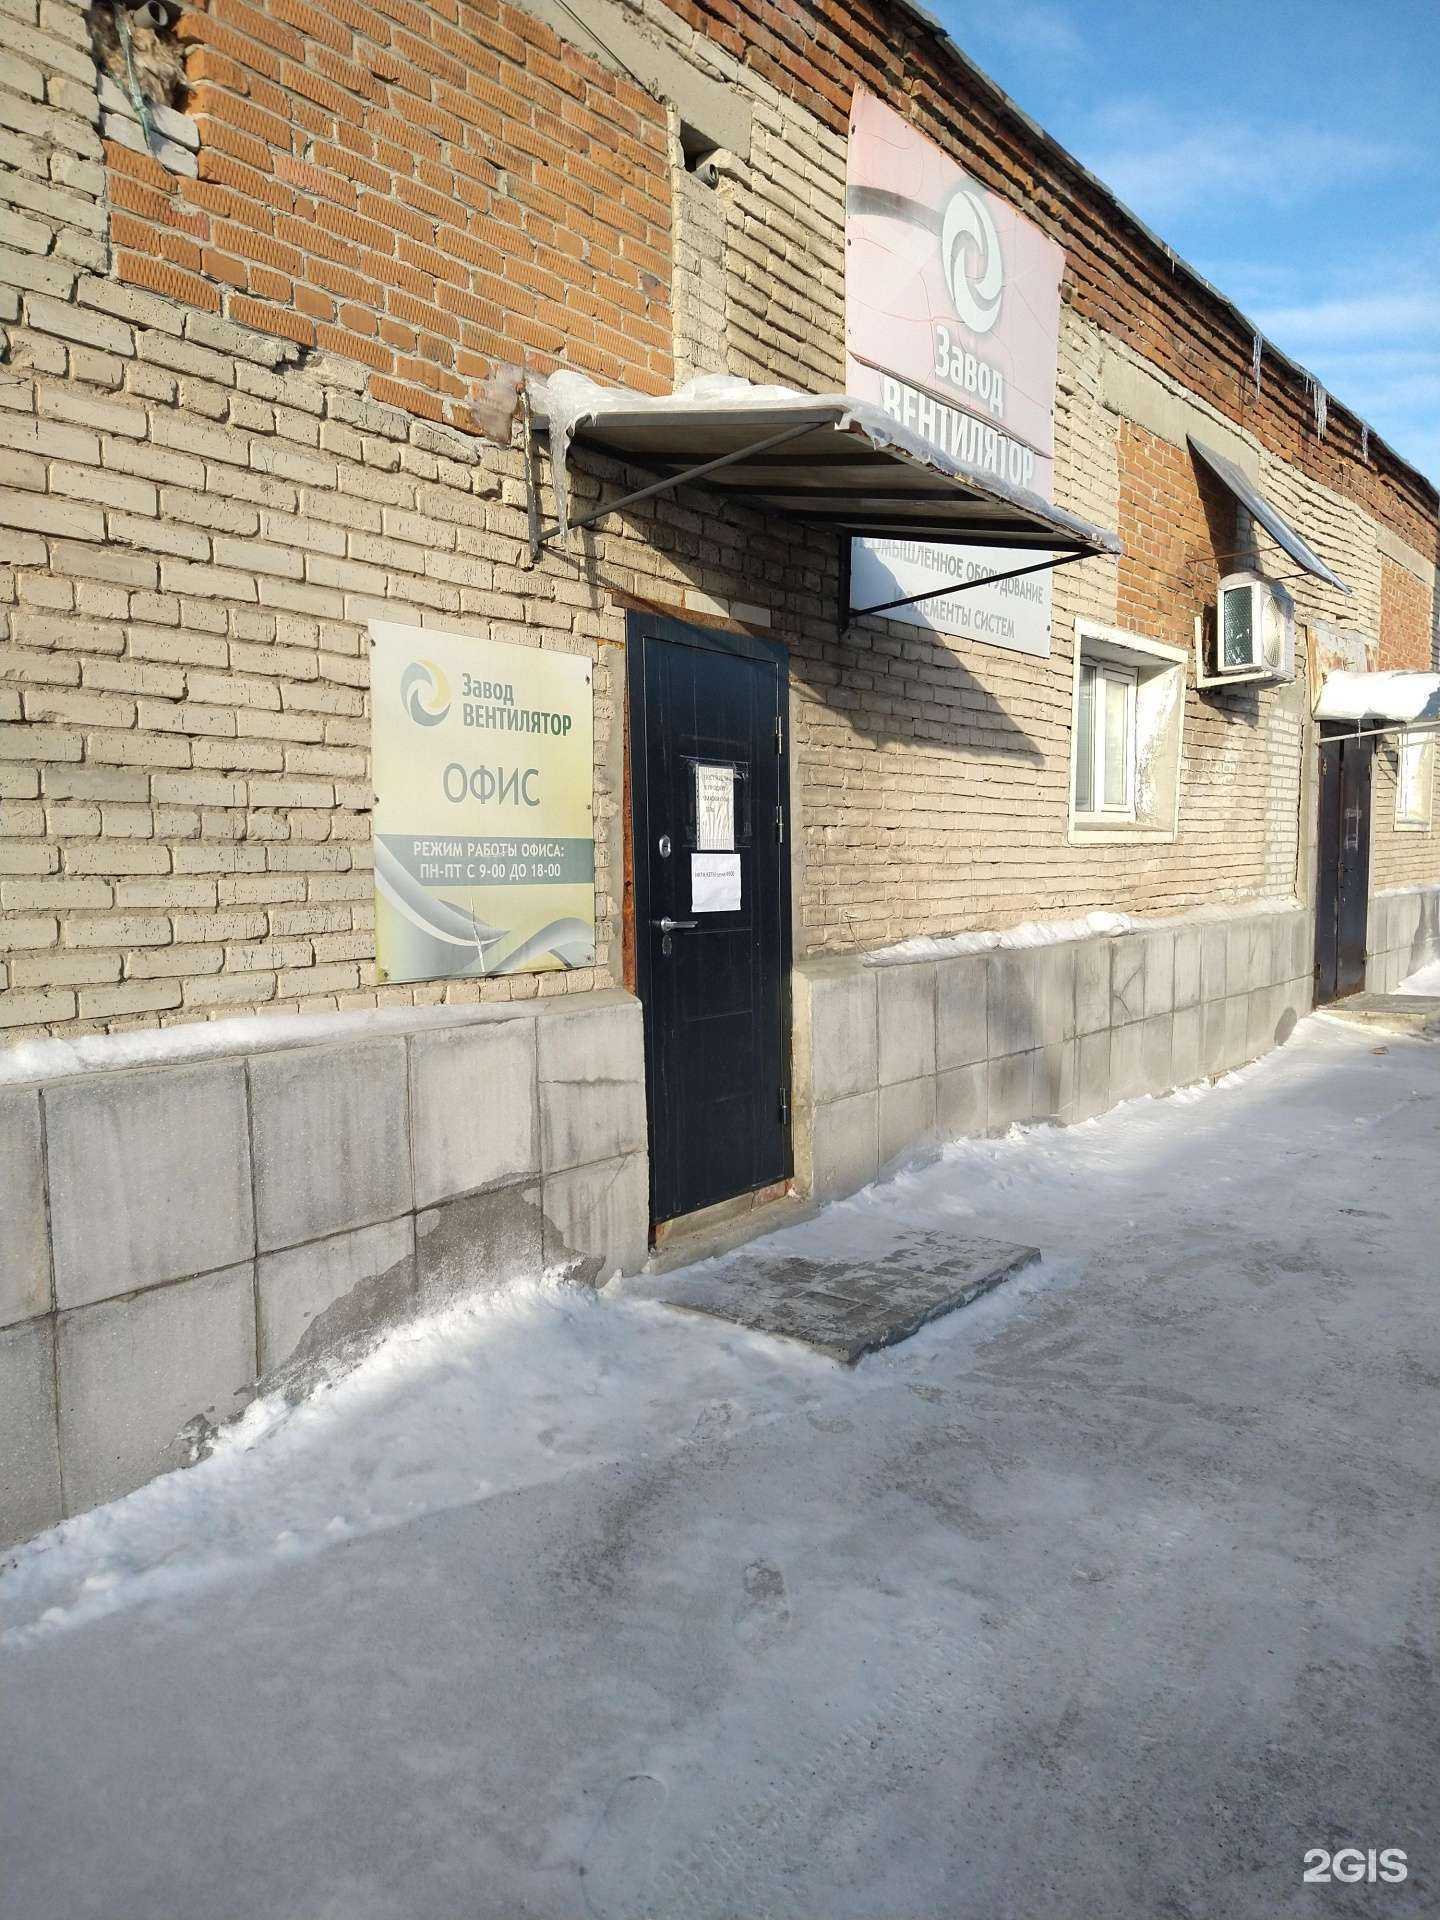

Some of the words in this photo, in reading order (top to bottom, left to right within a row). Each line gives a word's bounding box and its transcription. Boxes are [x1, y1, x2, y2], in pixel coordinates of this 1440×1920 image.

[935, 325, 1004, 418] Завод
[883, 375, 1034, 490] ВЕНТИЛЯТОР
[974, 609, 1015, 638] СИСТЕМ
[462, 673, 515, 705] Завод
[462, 703, 572, 737] ВЕНТИЛЯТОР
[443, 762, 540, 806] ОФИС
[413, 841, 463, 857] РЕЖИМ
[467, 843, 517, 857] РАБОТЫ
[521, 843, 565, 857] ОФИСА:
[420, 863, 462, 878] ПН-ПТ
[466, 864, 476, 878] С
[479, 864, 506, 878] 9-00
[509, 863, 527, 880] ДО
[531, 863, 561, 877] 18-00
